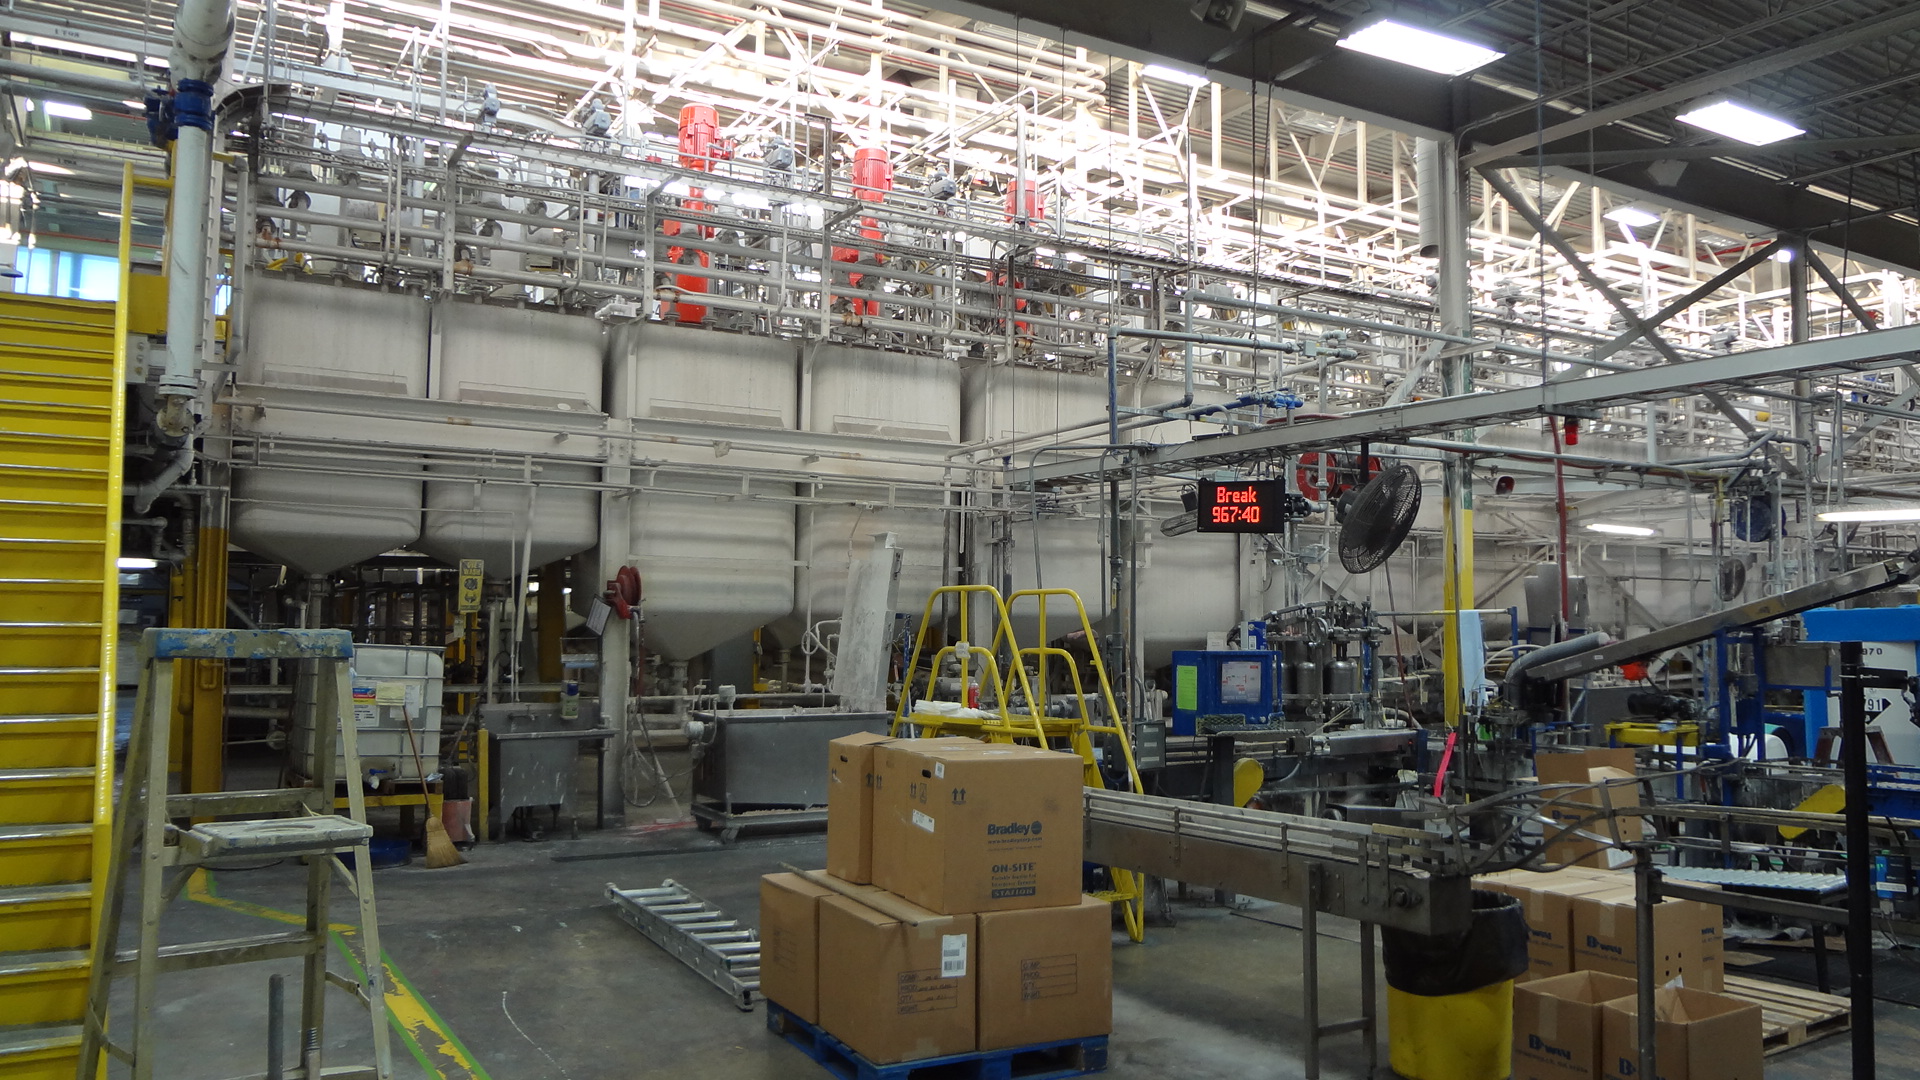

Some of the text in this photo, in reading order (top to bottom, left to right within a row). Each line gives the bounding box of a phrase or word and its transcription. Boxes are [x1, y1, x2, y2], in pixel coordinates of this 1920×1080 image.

[1217, 486, 1257, 503] Break
[1212, 506, 1260, 523] 967:40
[987, 822, 1031, 836] Bradley
[991, 862, 1034, 873] ON-SITE
[993, 888, 1034, 897] STATION
